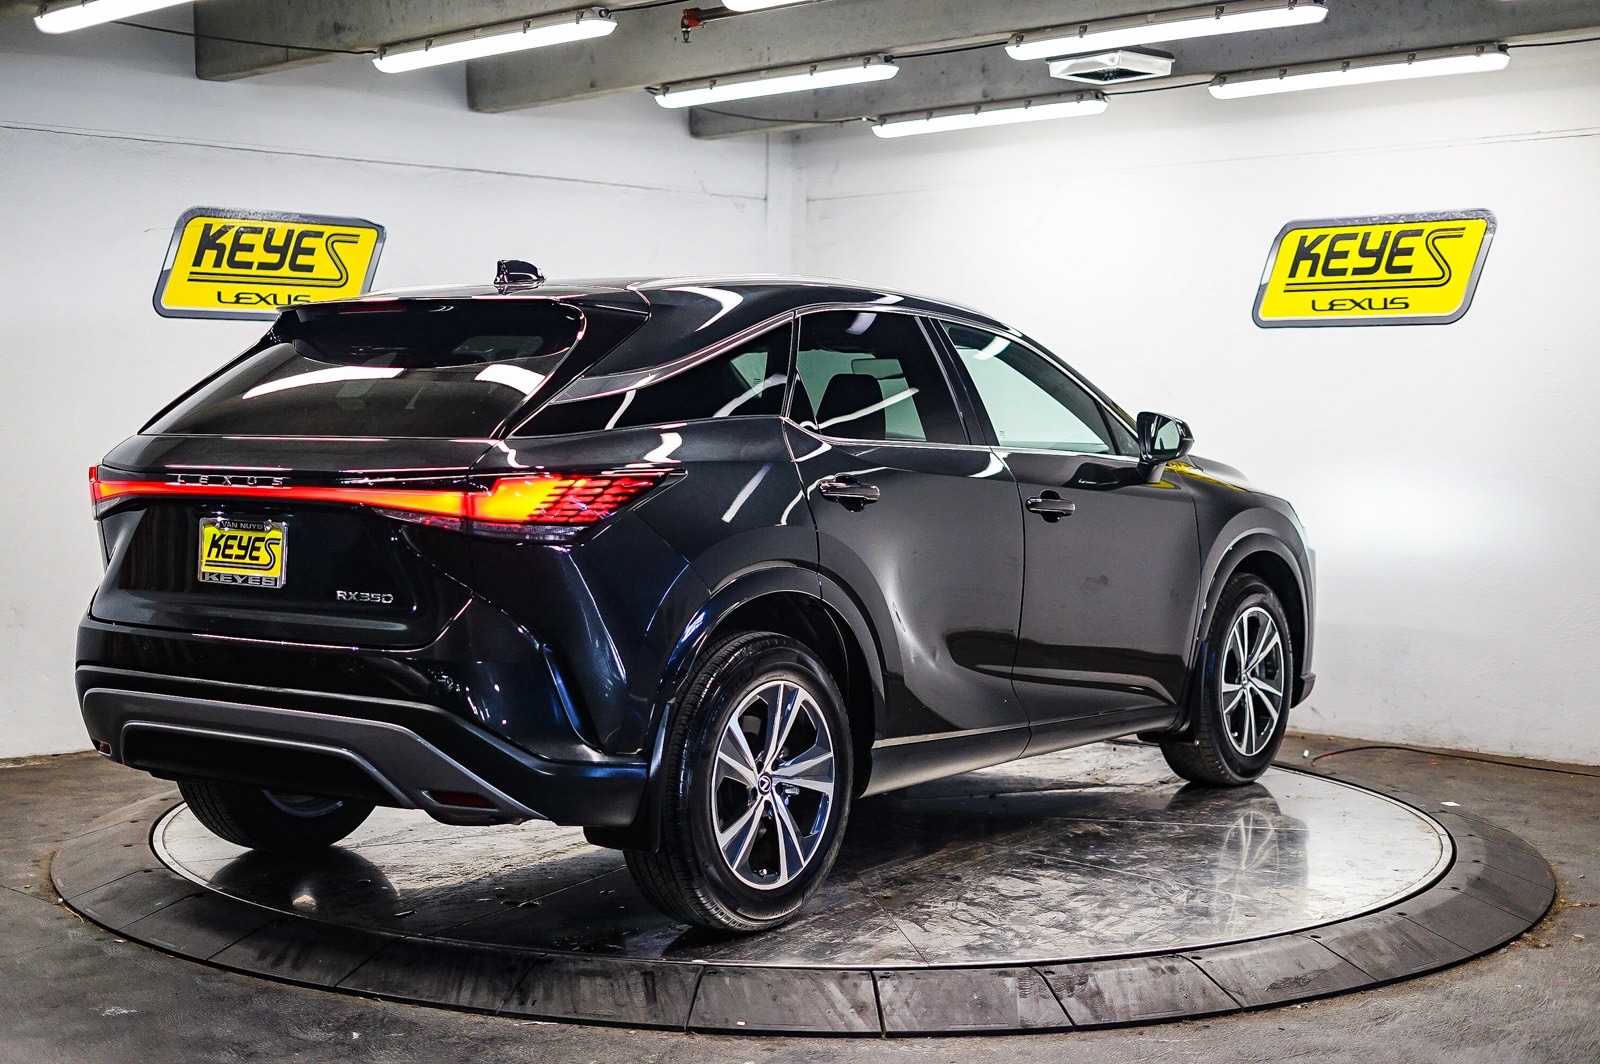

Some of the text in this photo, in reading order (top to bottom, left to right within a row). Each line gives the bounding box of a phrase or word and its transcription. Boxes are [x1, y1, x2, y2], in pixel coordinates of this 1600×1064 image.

[188, 224, 360, 287] KEYES
[1284, 227, 1466, 292] KEYES
[217, 291, 311, 305] LEXUS
[1311, 296, 1410, 312] LEXUS
[176, 474, 285, 486] LEXUS
[205, 534, 281, 571] KEYES
[204, 573, 276, 586] KEYES
[336, 590, 394, 604] RX350
